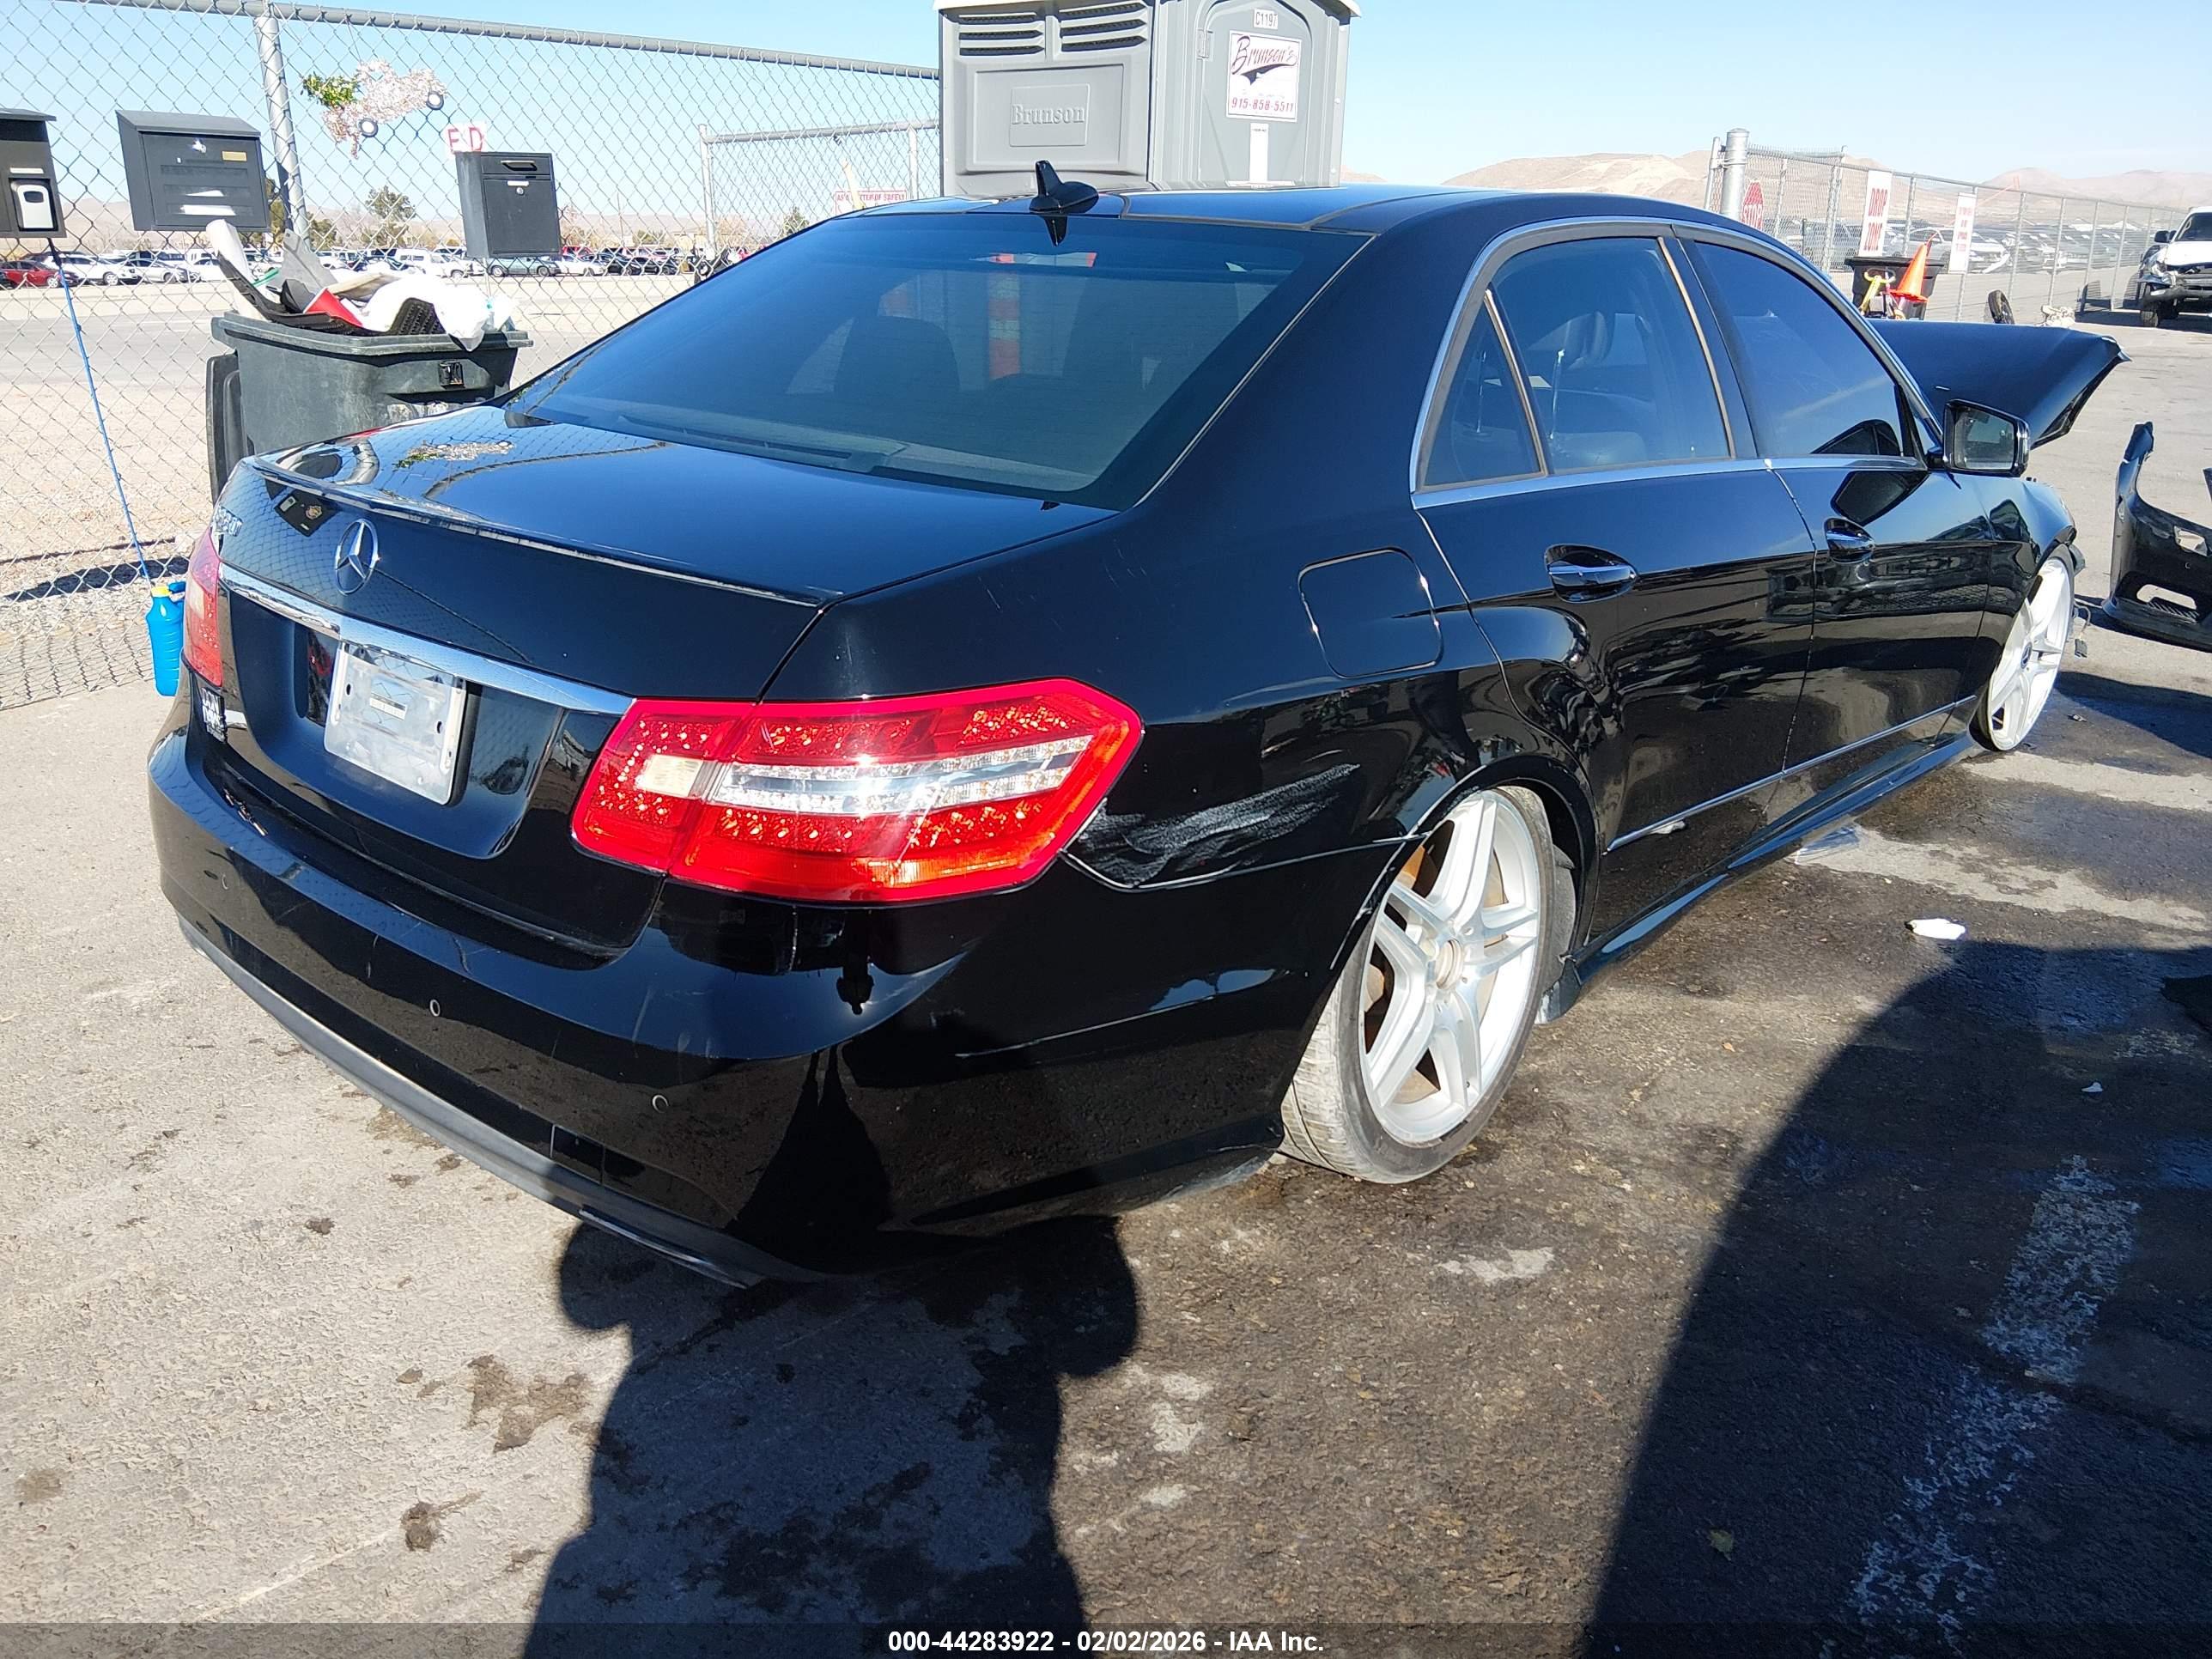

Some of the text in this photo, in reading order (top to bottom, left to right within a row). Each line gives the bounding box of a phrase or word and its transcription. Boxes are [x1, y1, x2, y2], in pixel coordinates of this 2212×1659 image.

[1255, 11, 1278, 27] C1197
[1231, 35, 1297, 75] Brunson's
[1012, 104, 1085, 125] Brunson
[1231, 97, 1294, 112] 915-858-5511
[1869, 187, 1888, 217] DROP
[1742, 204, 1763, 228] STOP
[1863, 222, 1883, 252] ZONE
